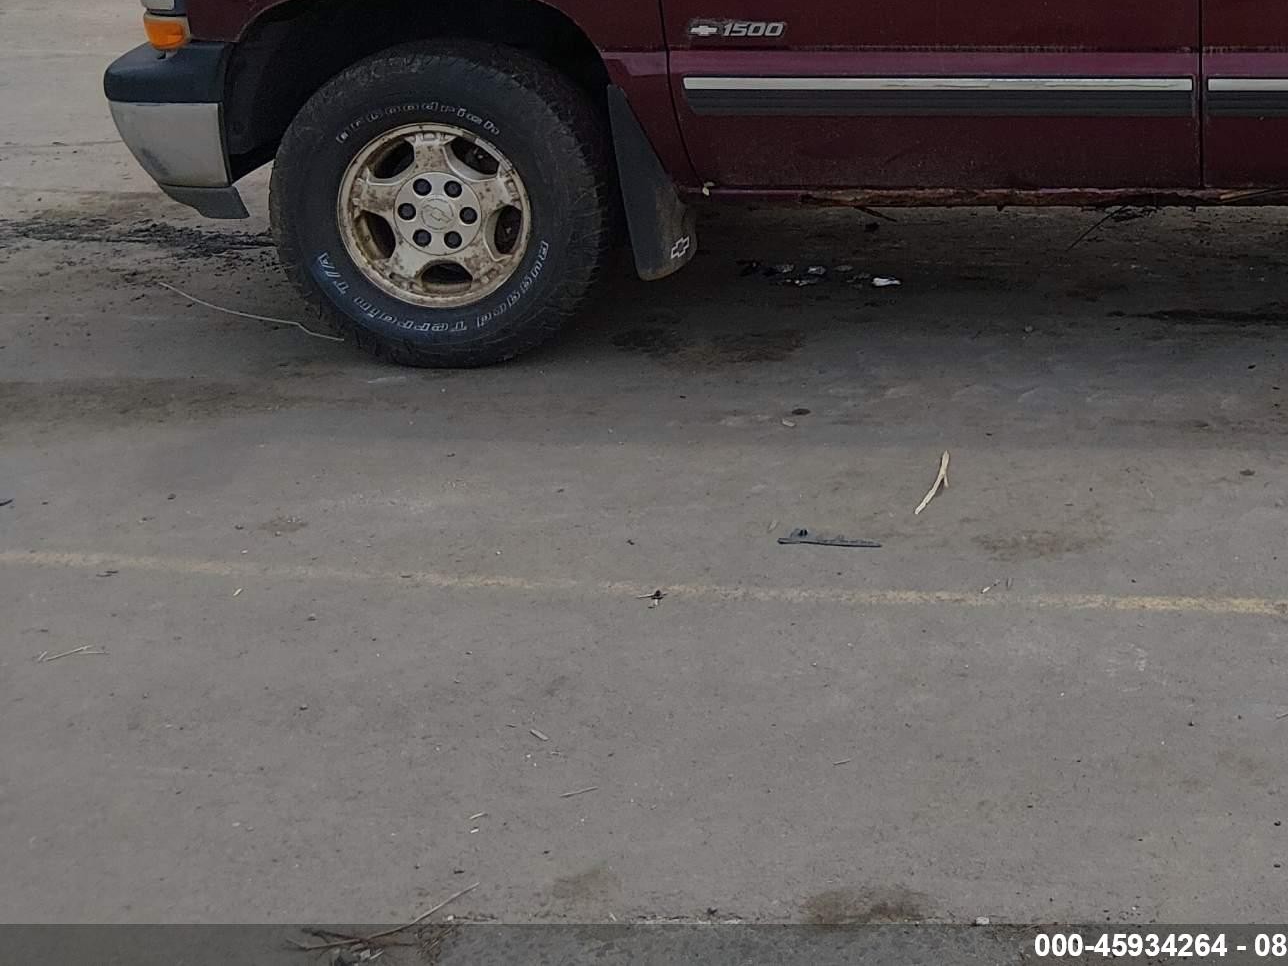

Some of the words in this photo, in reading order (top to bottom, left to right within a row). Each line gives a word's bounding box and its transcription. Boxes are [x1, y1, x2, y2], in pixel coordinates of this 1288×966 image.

[723, 22, 784, 37] 1500
[318, 252, 350, 294] T/A
[352, 296, 468, 332] Terrain
